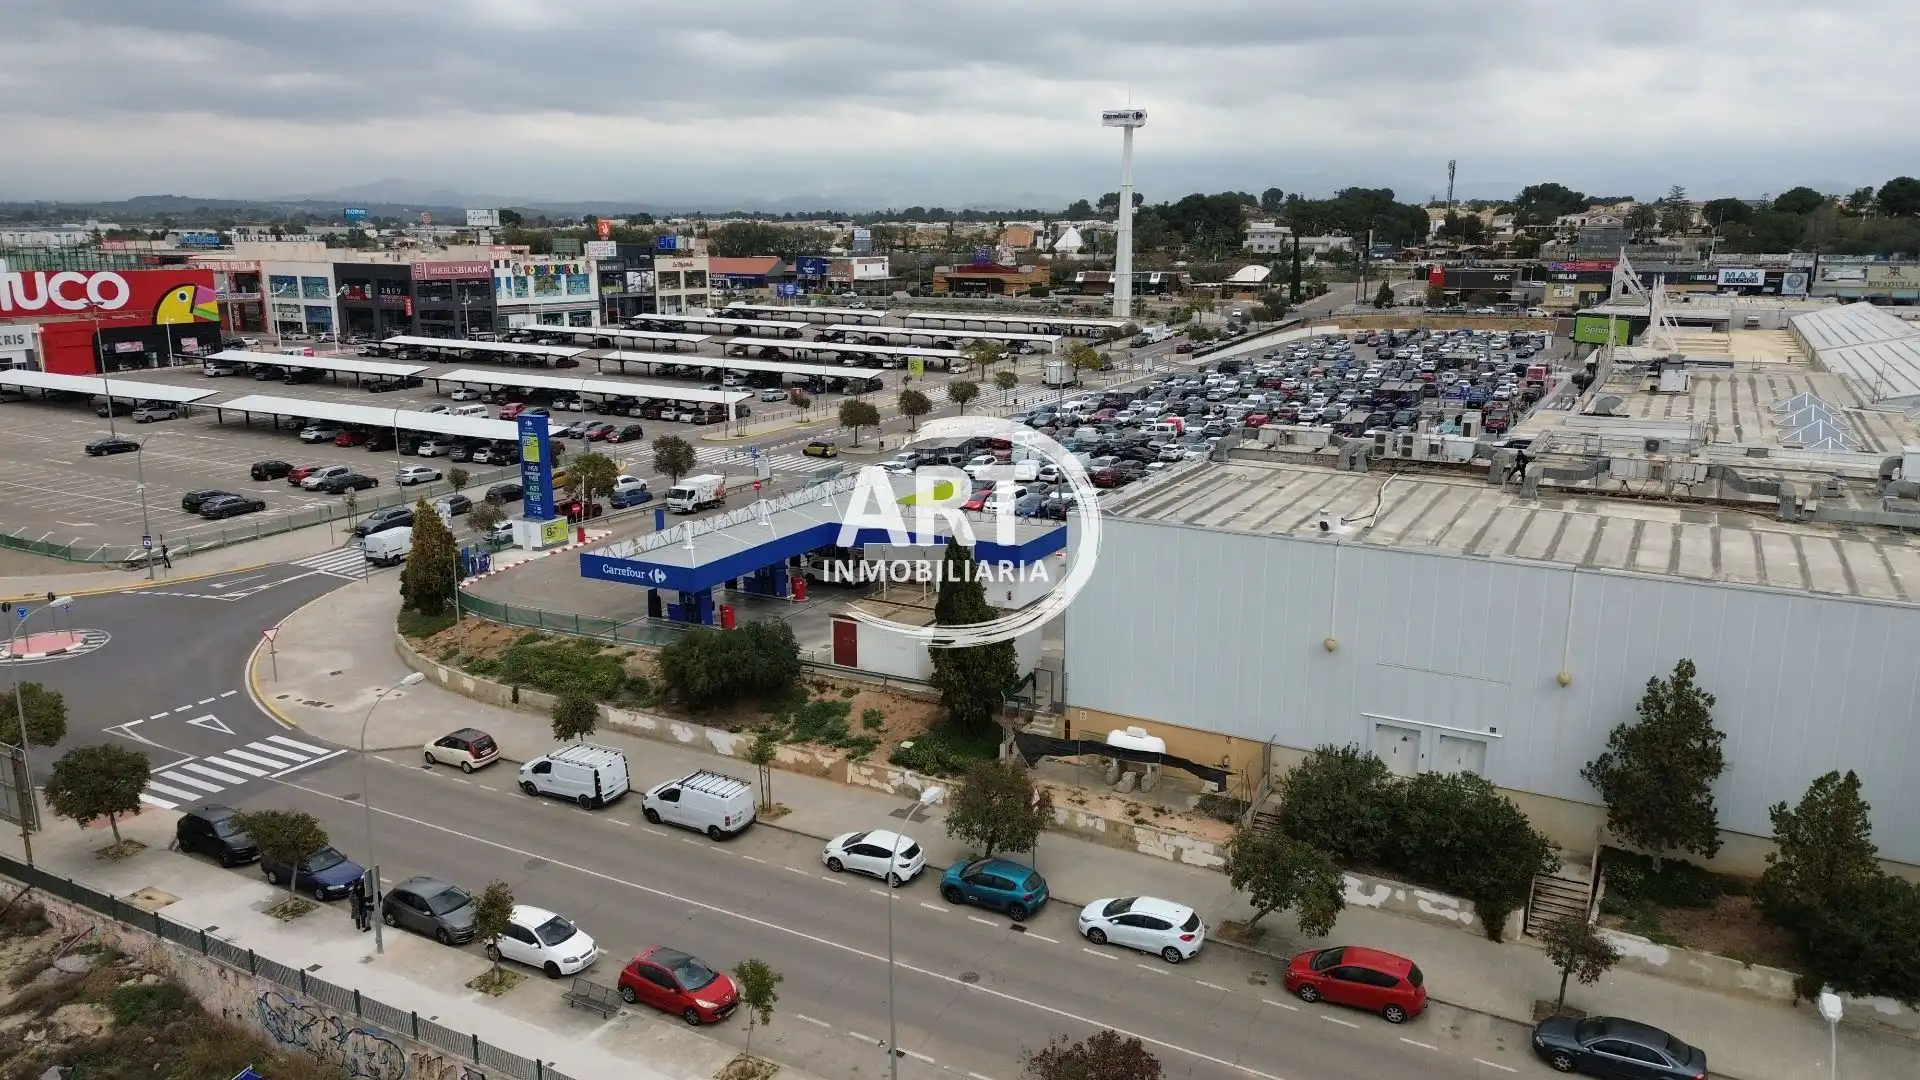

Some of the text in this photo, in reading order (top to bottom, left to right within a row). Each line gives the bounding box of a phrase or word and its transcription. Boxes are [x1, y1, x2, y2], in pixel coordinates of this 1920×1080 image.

[1103, 112, 1130, 120] Carrefour
[1724, 271, 1759, 279] MAX
[602, 563, 645, 579] Carrefour
